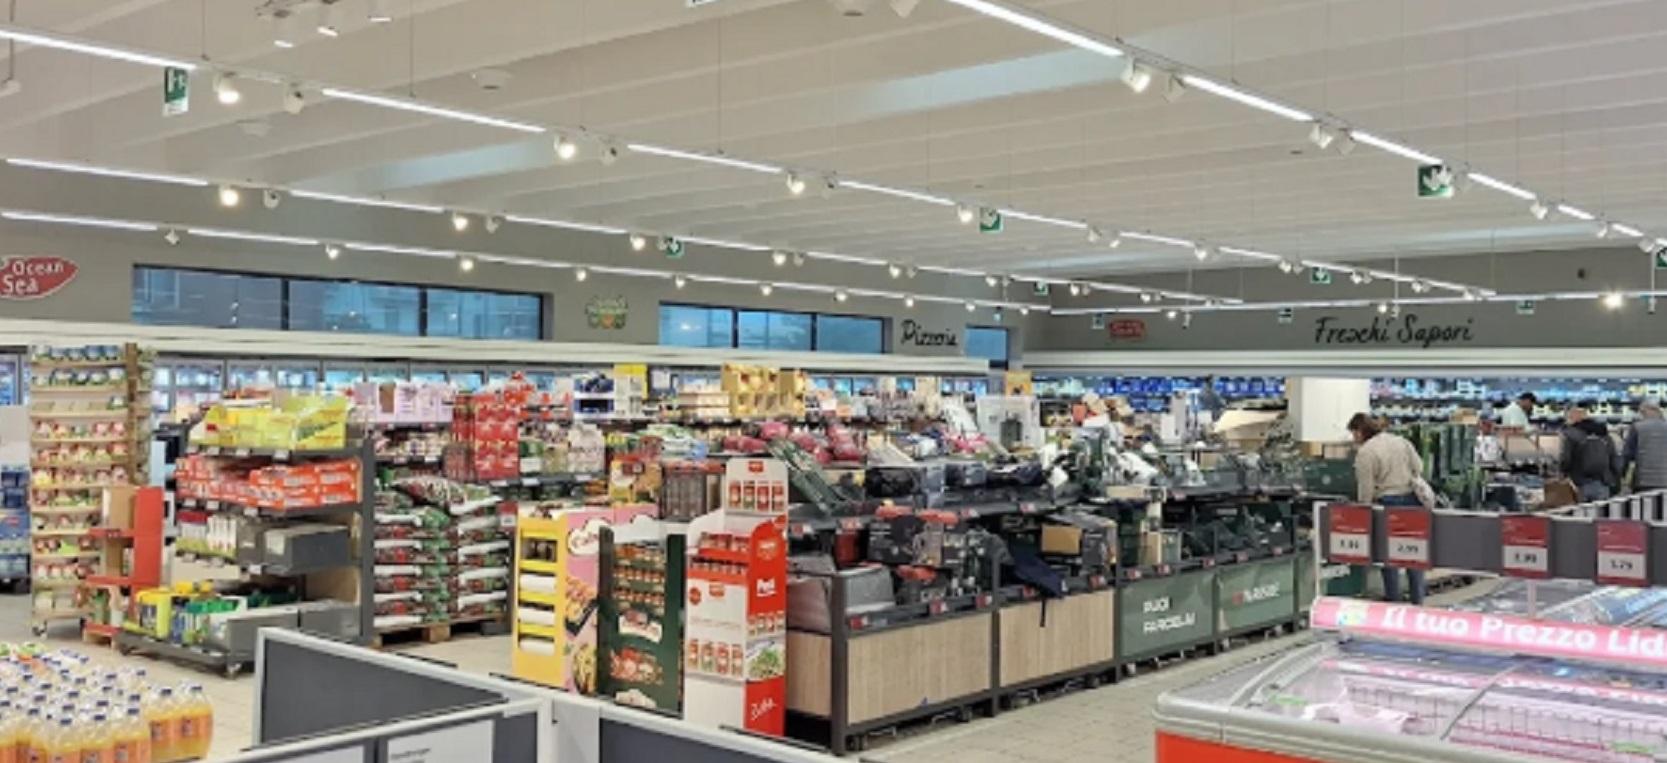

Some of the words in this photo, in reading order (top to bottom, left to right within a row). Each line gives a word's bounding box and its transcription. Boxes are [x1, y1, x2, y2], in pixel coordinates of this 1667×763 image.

[12, 260, 65, 275] Ocean
[3, 274, 39, 294] Sea
[1398, 314, 1475, 348] Sapori
[1382, 606, 1407, 629] Il
[1416, 612, 1469, 637] tuo
[1480, 616, 1598, 651] Prezzo
